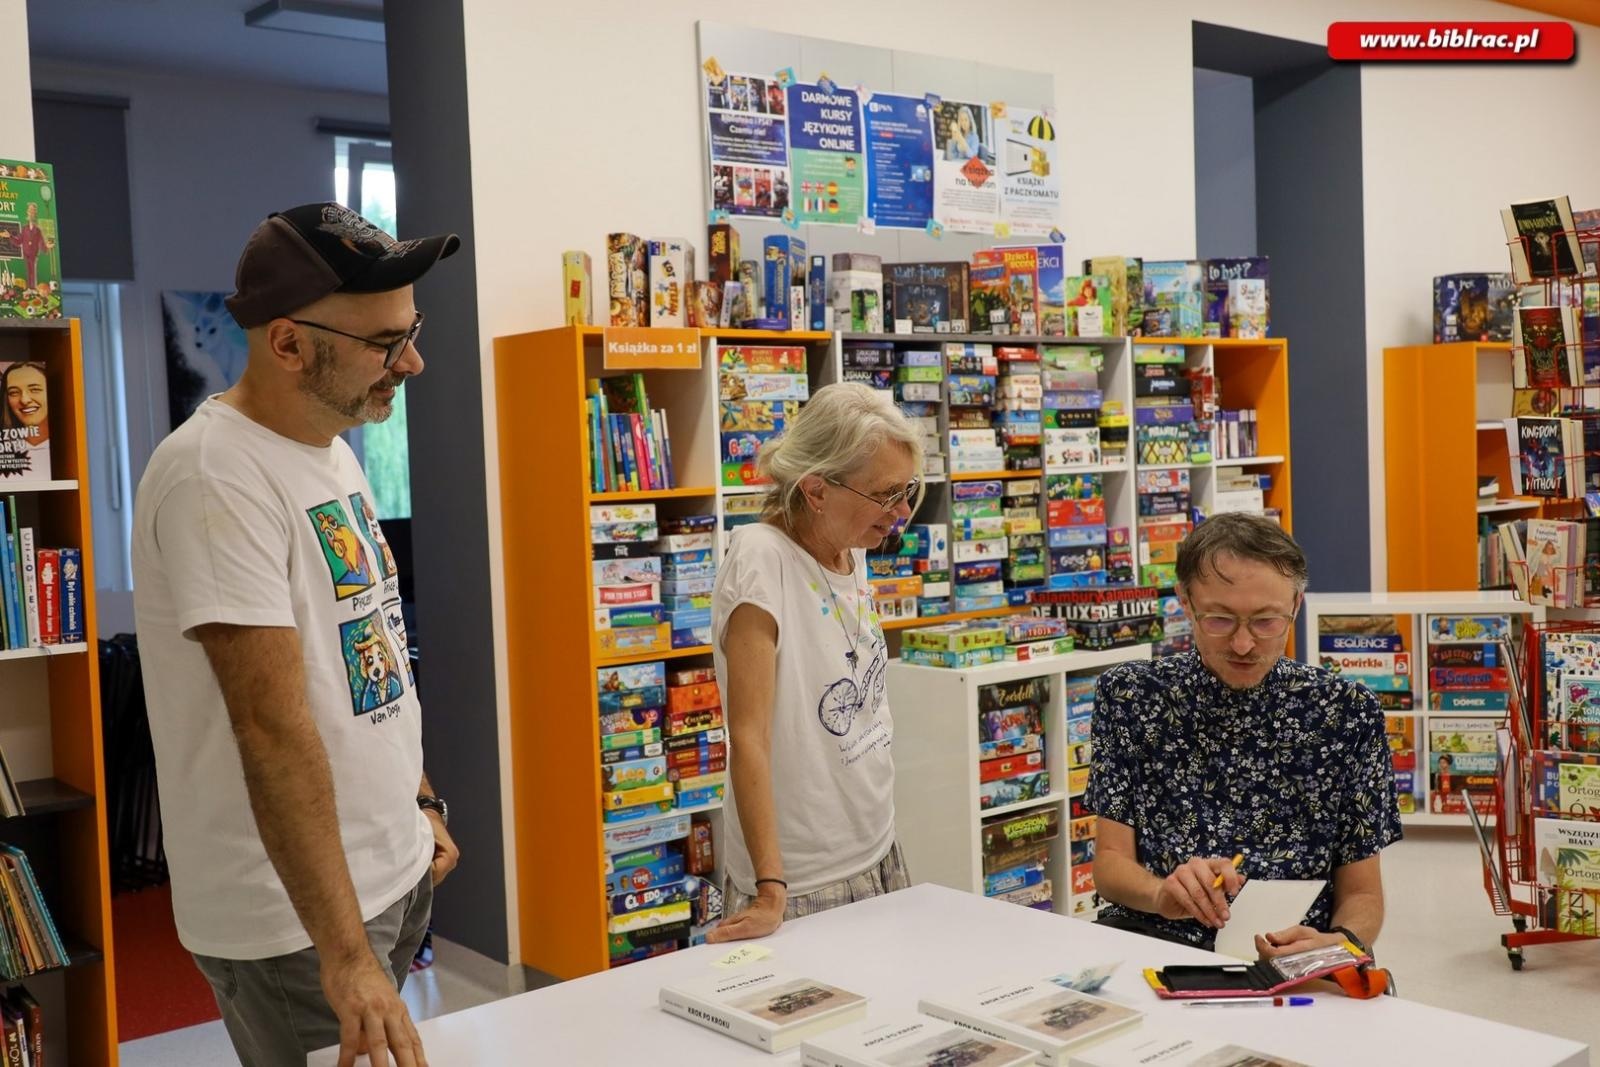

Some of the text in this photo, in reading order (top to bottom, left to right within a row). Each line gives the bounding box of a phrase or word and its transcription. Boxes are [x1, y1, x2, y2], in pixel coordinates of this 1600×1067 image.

[800, 91, 852, 107] DARMOWE
[820, 108, 853, 121] KURSY
[802, 121, 855, 136] JĘZYKOWE
[819, 137, 855, 151] ONLINE
[1017, 176, 1045, 187] KSIĄŻKI
[1010, 188, 1059, 199] PACZKOMATU
[608, 342, 698, 356] Książka za 1 zł
[1521, 424, 1558, 439] KINGDOM
[1526, 475, 1561, 491] WITHOUT
[1097, 587, 1158, 603] Kalambury
[1031, 606, 1051, 618] DE
[1099, 600, 1159, 619] DE LUXE
[1333, 637, 1388, 649] SEQUENCE
[1342, 657, 1384, 668] Qwirkle
[370, 711, 387, 726] Van
[1568, 837, 1594, 847] BIAŁY
[625, 889, 660, 910] CLUEDO
[687, 1006, 731, 1030] KROK PO KROKU
